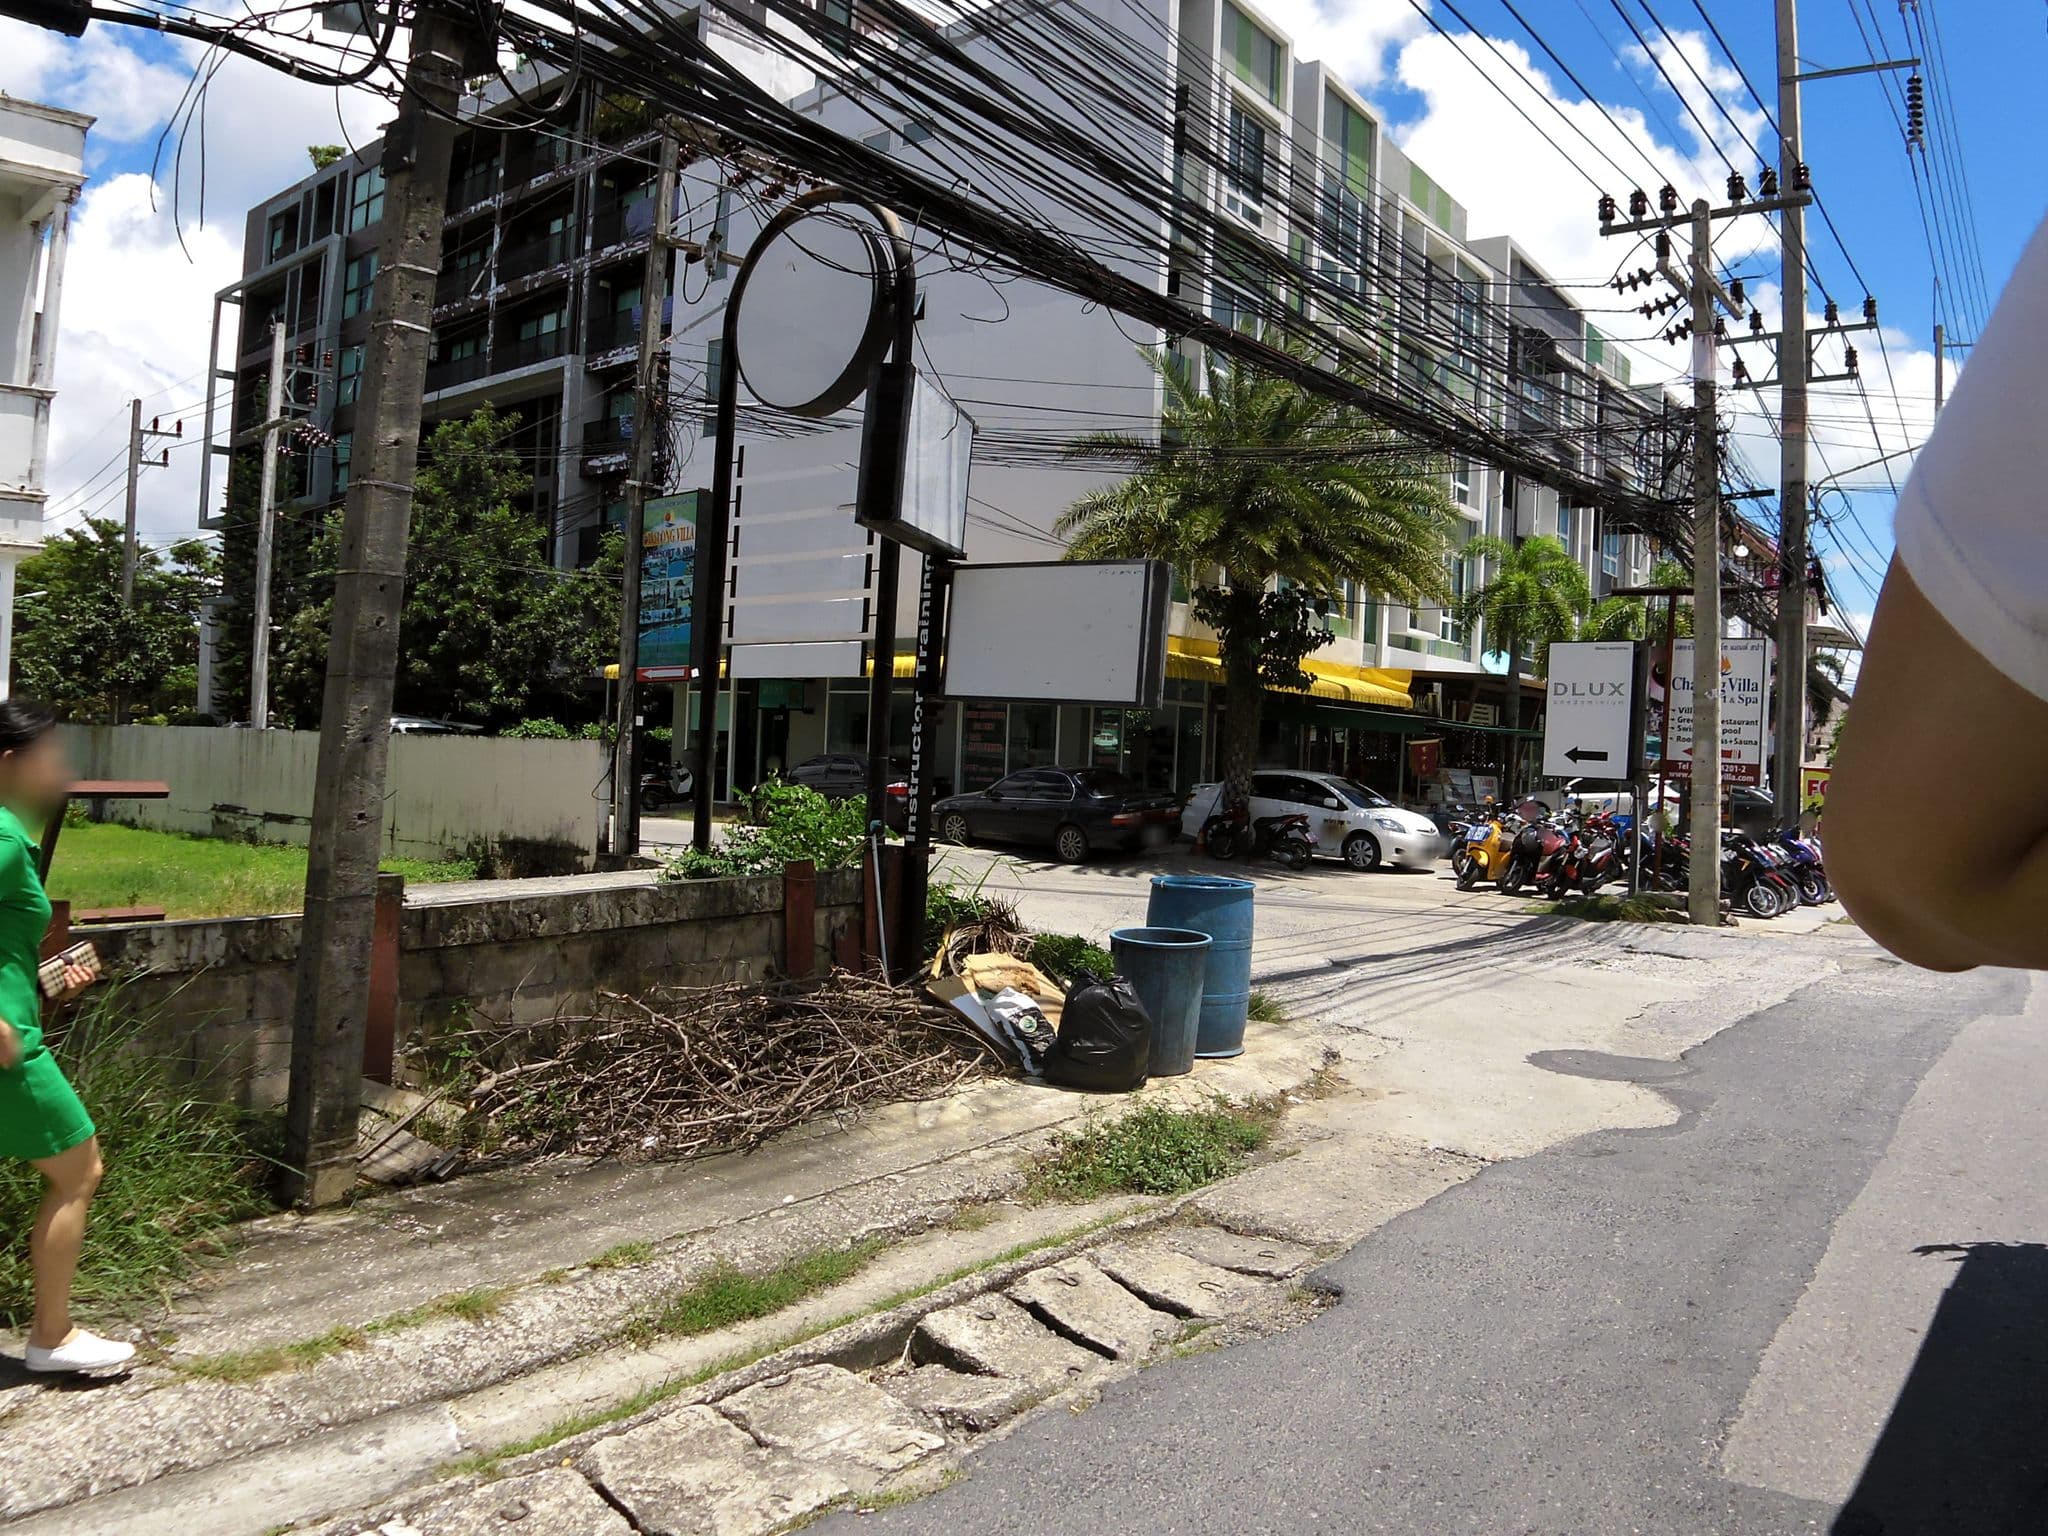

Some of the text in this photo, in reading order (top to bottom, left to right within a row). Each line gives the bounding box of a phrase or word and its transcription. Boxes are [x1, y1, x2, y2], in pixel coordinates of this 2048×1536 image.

[1553, 682, 1625, 697] DLUX
[1728, 677, 1759, 692] Villa
[906, 554, 935, 842] Instructor Training
[1737, 694, 1758, 706] Spa
[1722, 727, 1741, 735] pool
